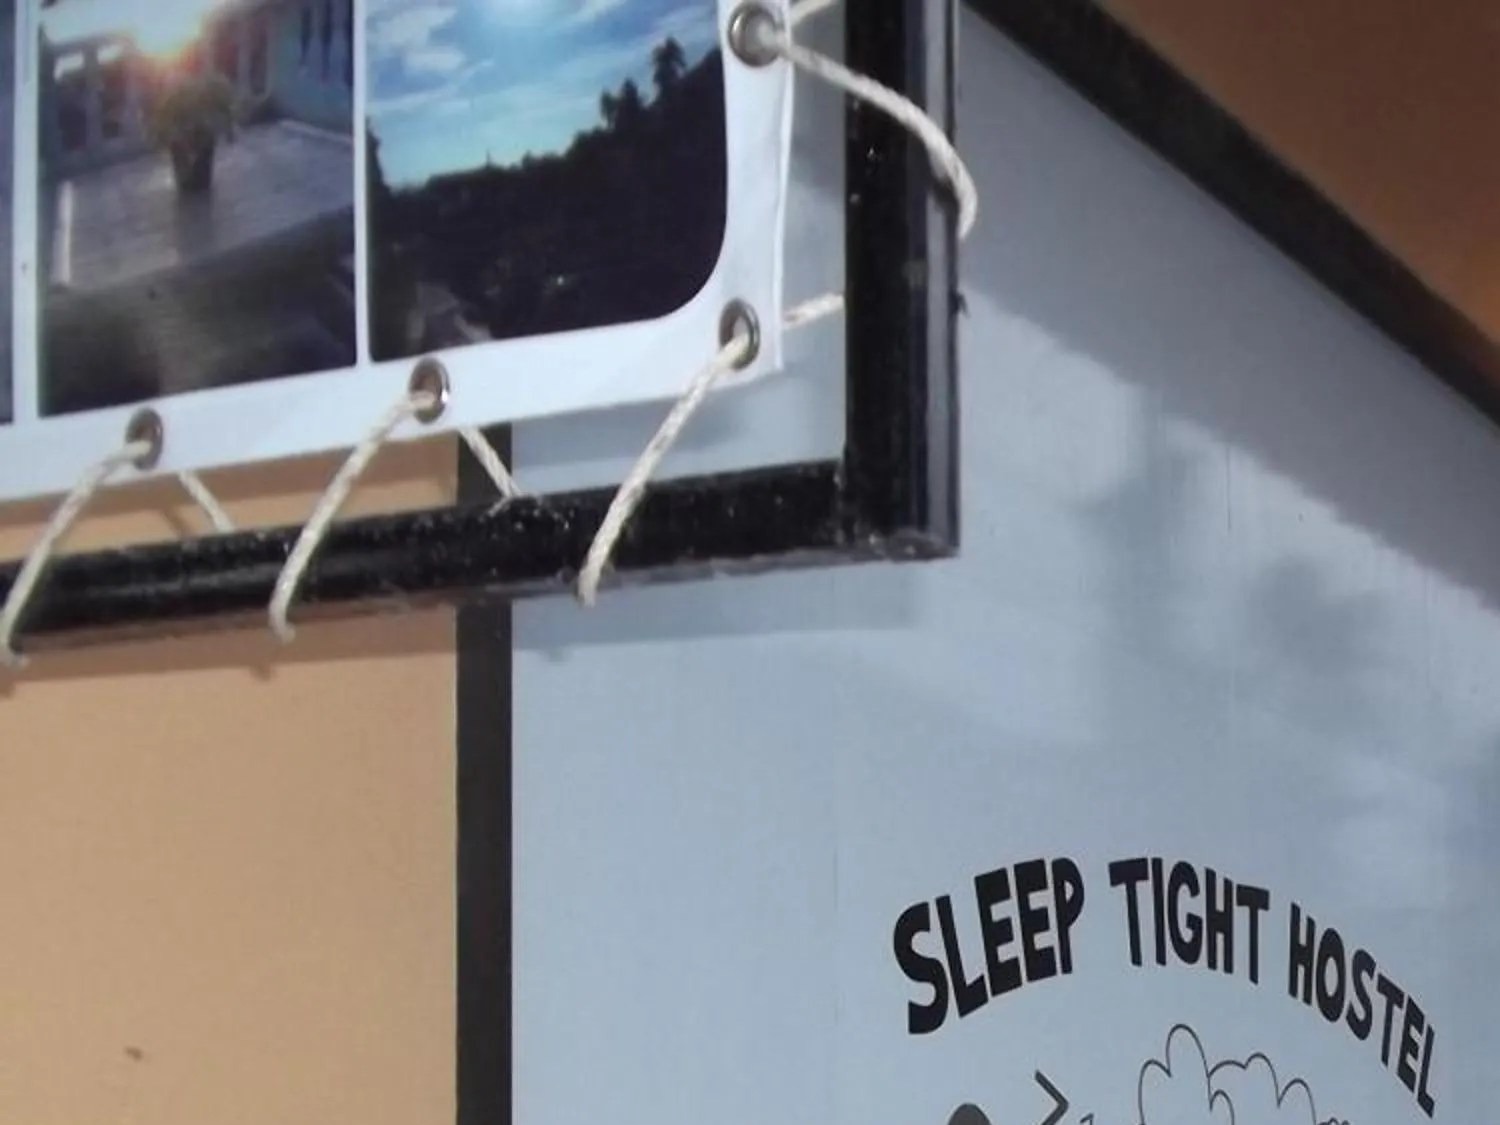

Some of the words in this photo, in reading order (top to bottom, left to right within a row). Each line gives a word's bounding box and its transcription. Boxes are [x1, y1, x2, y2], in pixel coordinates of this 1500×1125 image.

[892, 857, 1085, 1035] SLEEP
[1108, 857, 1270, 985] TIGHT
[1287, 902, 1436, 1119] HOSTEL
